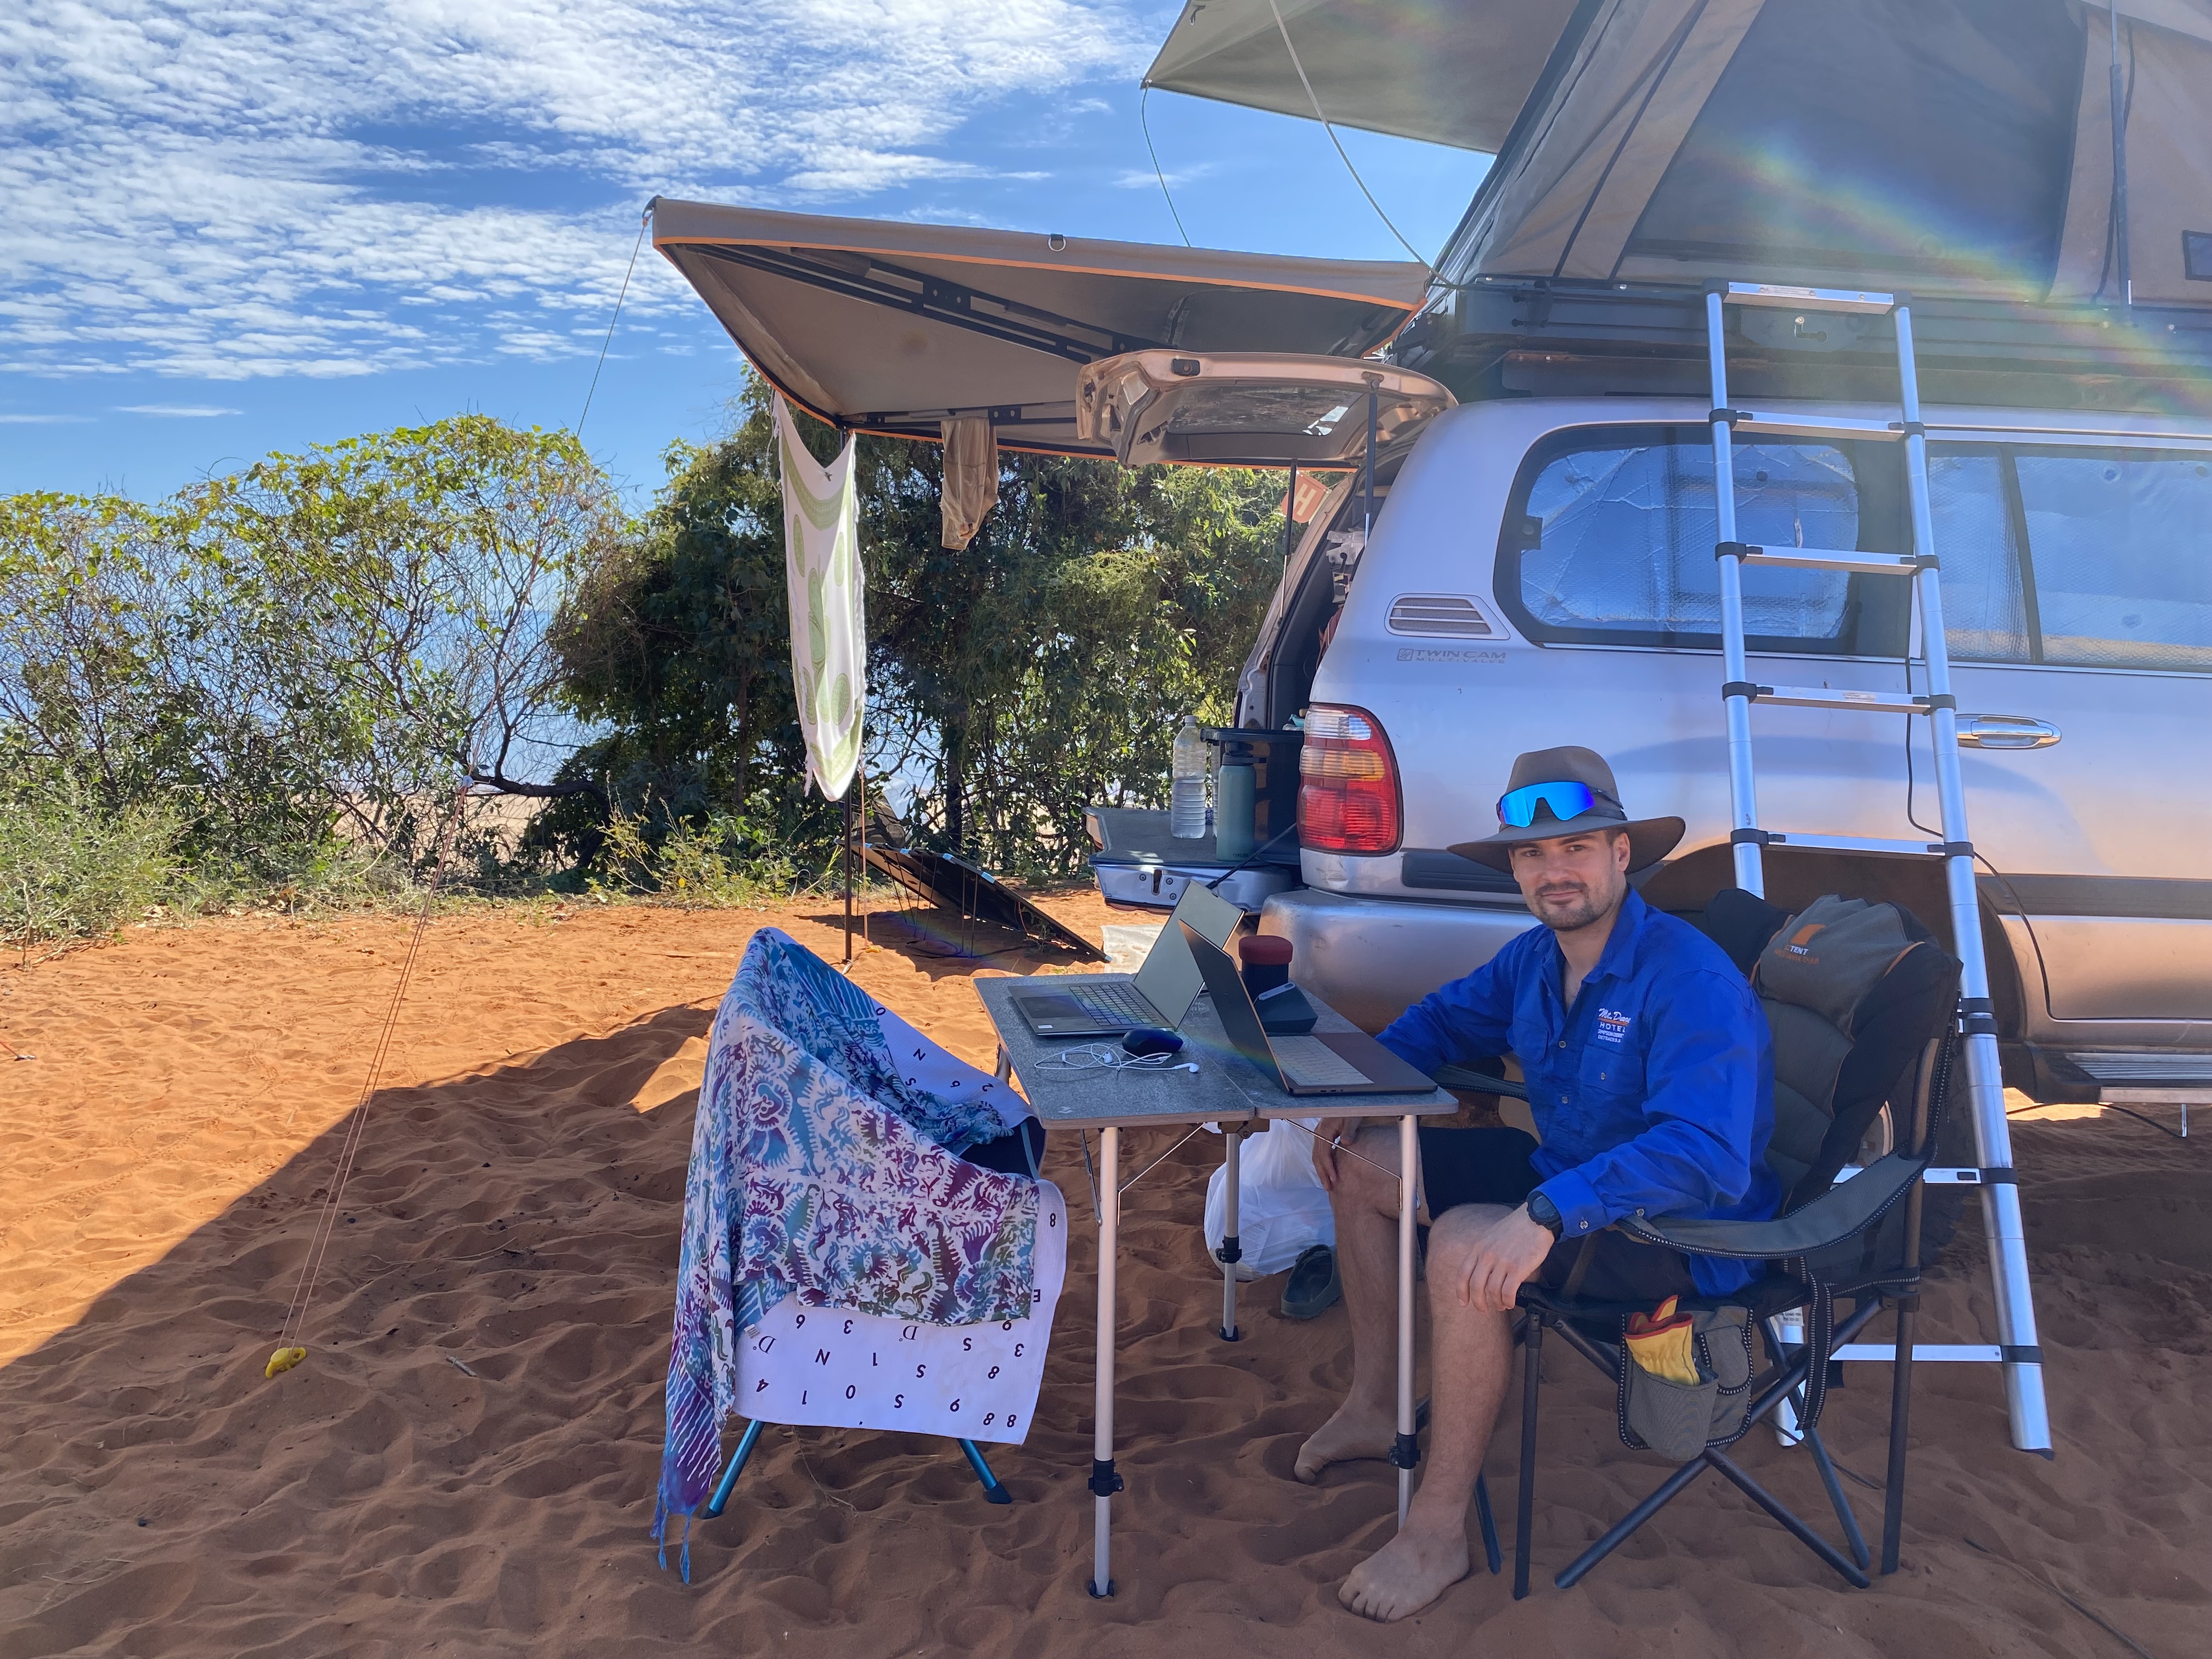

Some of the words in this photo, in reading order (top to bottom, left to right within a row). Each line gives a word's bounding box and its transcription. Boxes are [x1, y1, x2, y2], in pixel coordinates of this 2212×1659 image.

[1414, 649, 1460, 658] TWIN
[1599, 1021, 1626, 1033] HOTEL
[1049, 1212, 1056, 1228] 8
[1033, 1289, 1041, 1303] E
[843, 1319, 854, 1334] 3
[815, 1348, 831, 1365] N
[1014, 1343, 1024, 1357] 3
[988, 1365, 1000, 1379] 8
[756, 1379, 769, 1392] 4
